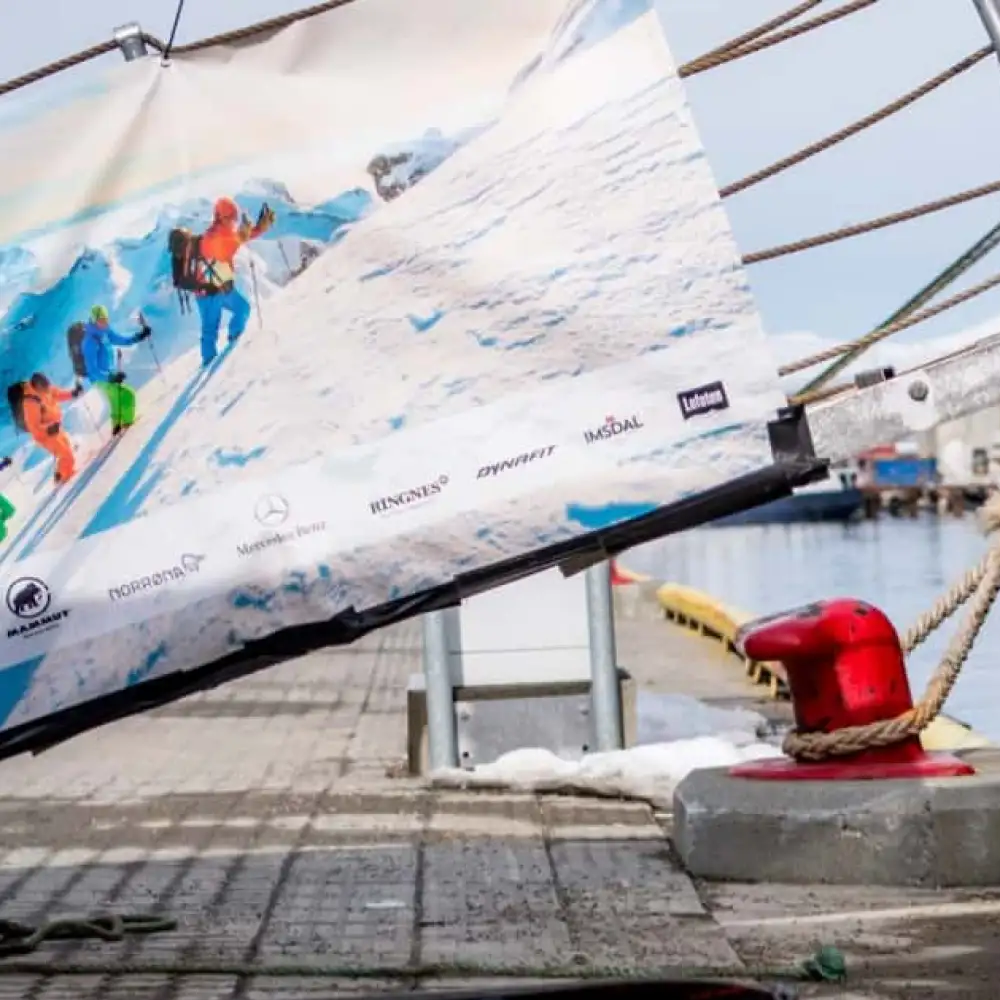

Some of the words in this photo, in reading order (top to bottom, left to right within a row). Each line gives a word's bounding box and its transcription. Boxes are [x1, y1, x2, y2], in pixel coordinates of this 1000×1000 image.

[584, 415, 644, 444] IMSDAL
[477, 444, 557, 480] DYNAFIT
[369, 481, 443, 515] RINGNES
[7, 609, 71, 638] MAMMUT
